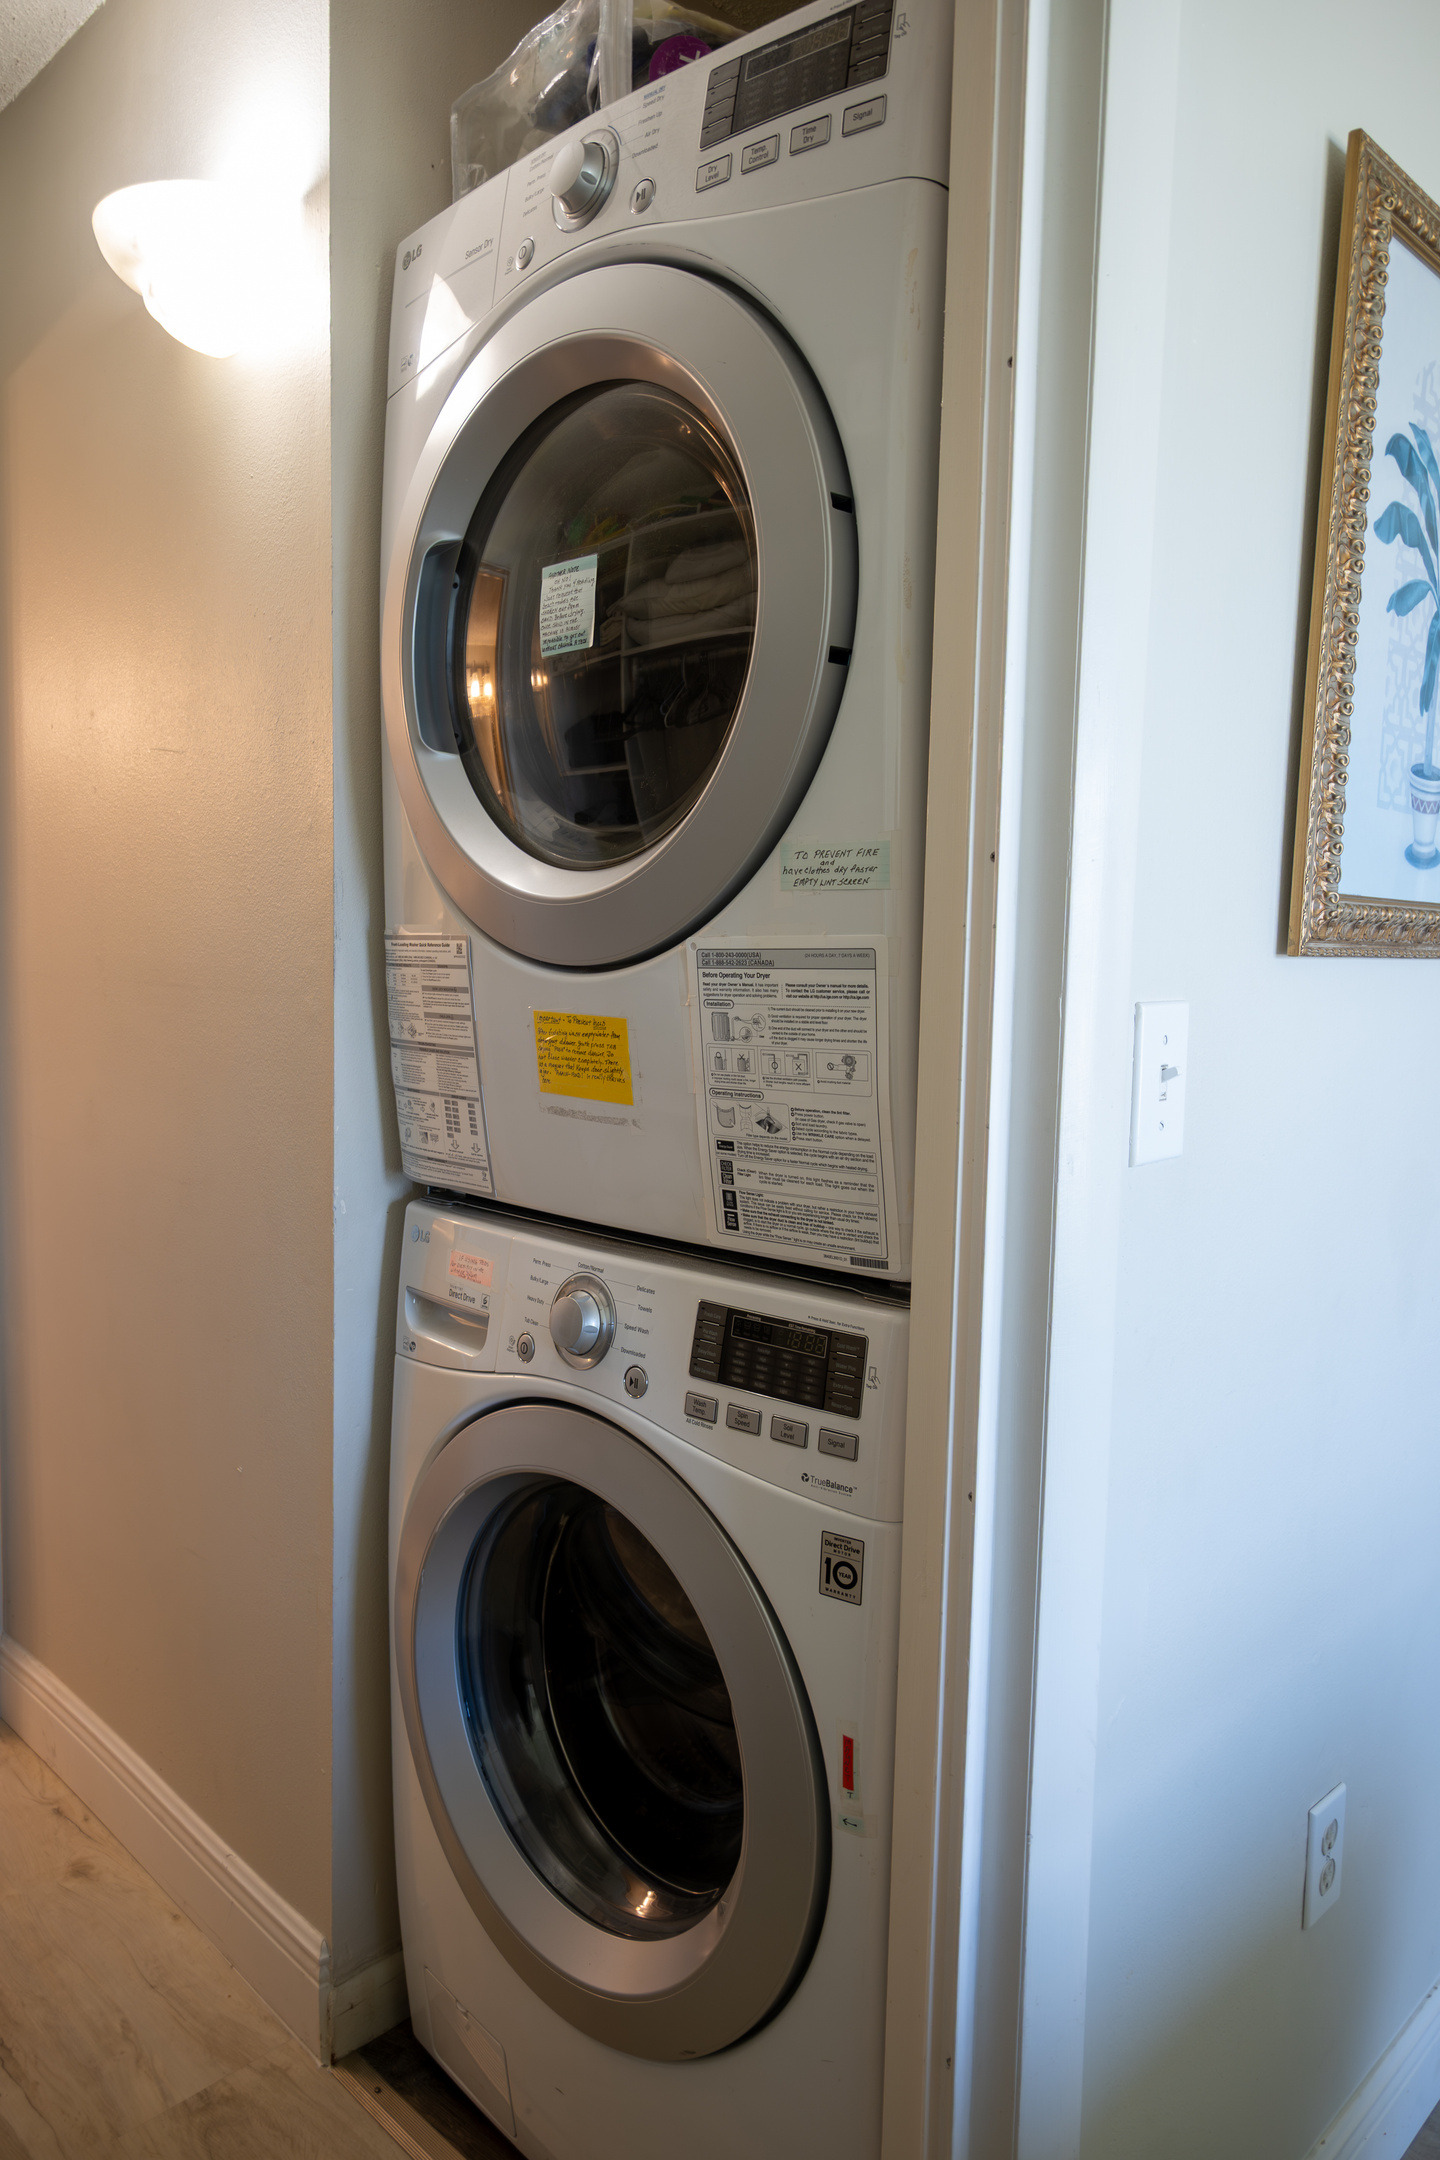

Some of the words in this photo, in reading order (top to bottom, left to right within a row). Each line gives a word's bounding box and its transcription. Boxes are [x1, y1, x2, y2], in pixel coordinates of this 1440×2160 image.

[642, 98, 656, 109] Speed
[638, 114, 655, 126] Freshen
[852, 108, 873, 121] Signal
[652, 128, 660, 137] Dry
[802, 126, 817, 136] Time
[803, 134, 814, 143] Dry
[631, 143, 659, 160] Downloaded
[751, 144, 767, 156] Temp.
[748, 152, 769, 165] Control
[707, 164, 717, 174] Dry
[705, 172, 719, 182] Level
[465, 242, 483, 260] Sensor
[484, 237, 494, 249] Dry
[794, 850, 809, 860] TO
[813, 848, 854, 859] PREVENT
[856, 848, 880, 858] FIRE
[793, 877, 819, 887] EMPTY
[820, 878, 836, 887] LINT
[837, 876, 871, 886] SCREEN
[748, 959, 775, 967] (CANADA)
[719, 972, 743, 980] Operating
[756, 972, 771, 980] Dryer
[711, 1090, 734, 1098] Operating
[734, 1091, 761, 1099] Instructions
[577, 1261, 604, 1273] Cotton/Normal
[636, 1285, 655, 1295] Delicates
[448, 1288, 463, 1301] Direct
[463, 1292, 476, 1304] Drive
[638, 1304, 653, 1313] Towels
[624, 1323, 637, 1332] Speed
[637, 1326, 649, 1335] Wash
[621, 1347, 646, 1359] Downloaded
[693, 1398, 707, 1408] Wash
[692, 1406, 706, 1416] Temp.
[737, 1411, 749, 1420] Spin
[734, 1418, 750, 1428] Speed
[783, 1424, 793, 1432] Soil
[780, 1430, 794, 1441] Level
[827, 1438, 846, 1449] Signal
[824, 1539, 843, 1550] Direct
[843, 1544, 860, 1554] Drive
[833, 1549, 851, 1557] MOTOR
[824, 1556, 858, 1590] 10
[839, 1571, 852, 1580] YEAR
[825, 1586, 856, 1600] WARRANTY
